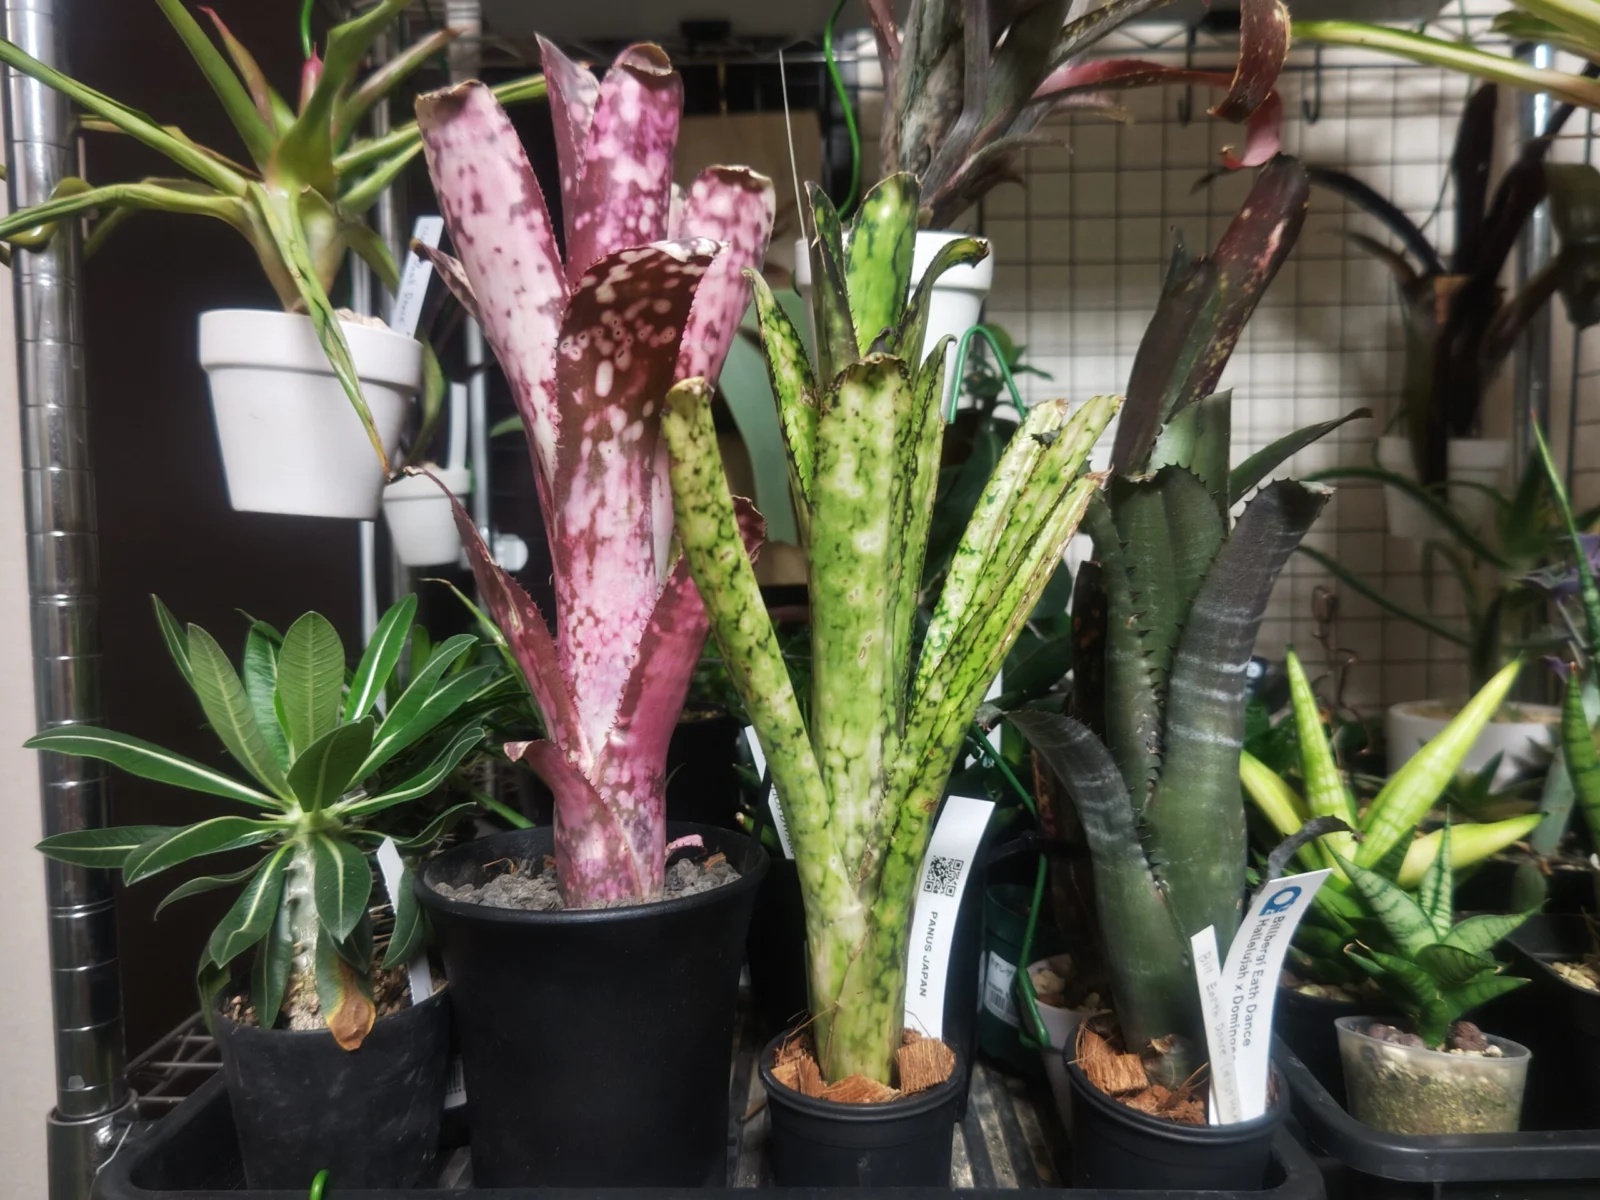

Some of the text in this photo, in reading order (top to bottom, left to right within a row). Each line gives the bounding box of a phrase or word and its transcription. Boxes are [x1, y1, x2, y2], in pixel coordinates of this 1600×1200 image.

[919, 911, 938, 997] PANUS JAPAN
[1236, 918, 1270, 980] Hallelujah
[1242, 915, 1285, 1047] Billbergi Eath Dance
[1234, 984, 1243, 992] x
